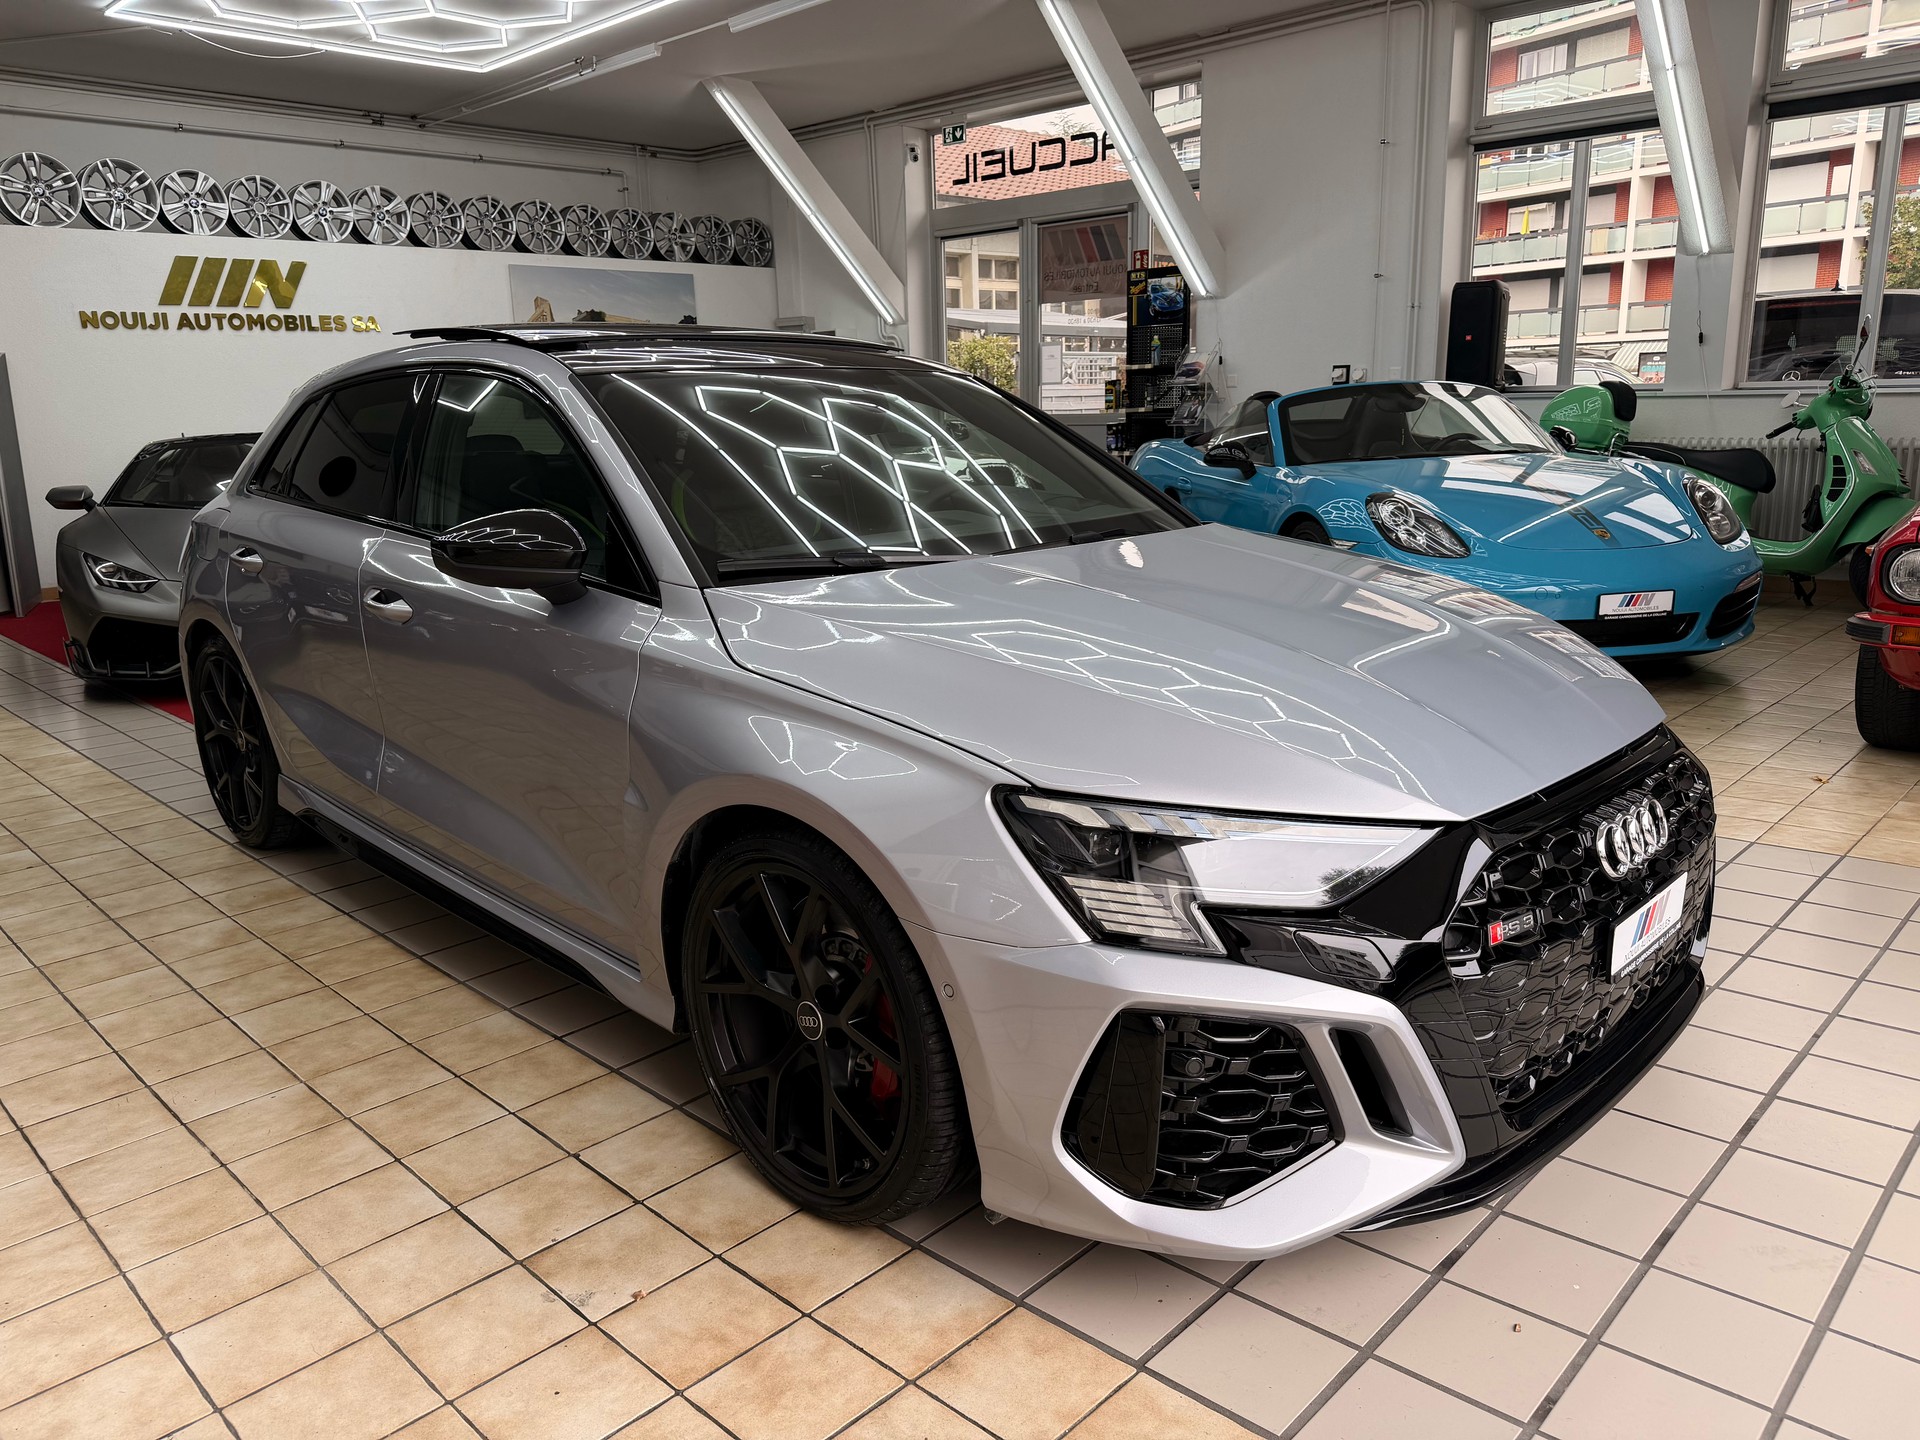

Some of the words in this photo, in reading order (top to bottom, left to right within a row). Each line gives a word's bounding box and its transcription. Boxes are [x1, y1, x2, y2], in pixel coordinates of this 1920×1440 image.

[79, 310, 169, 331] NOUIJI
[176, 312, 347, 332] AUTOMOBILES
[351, 315, 382, 333] SA
[1523, 914, 1535, 928] 3
